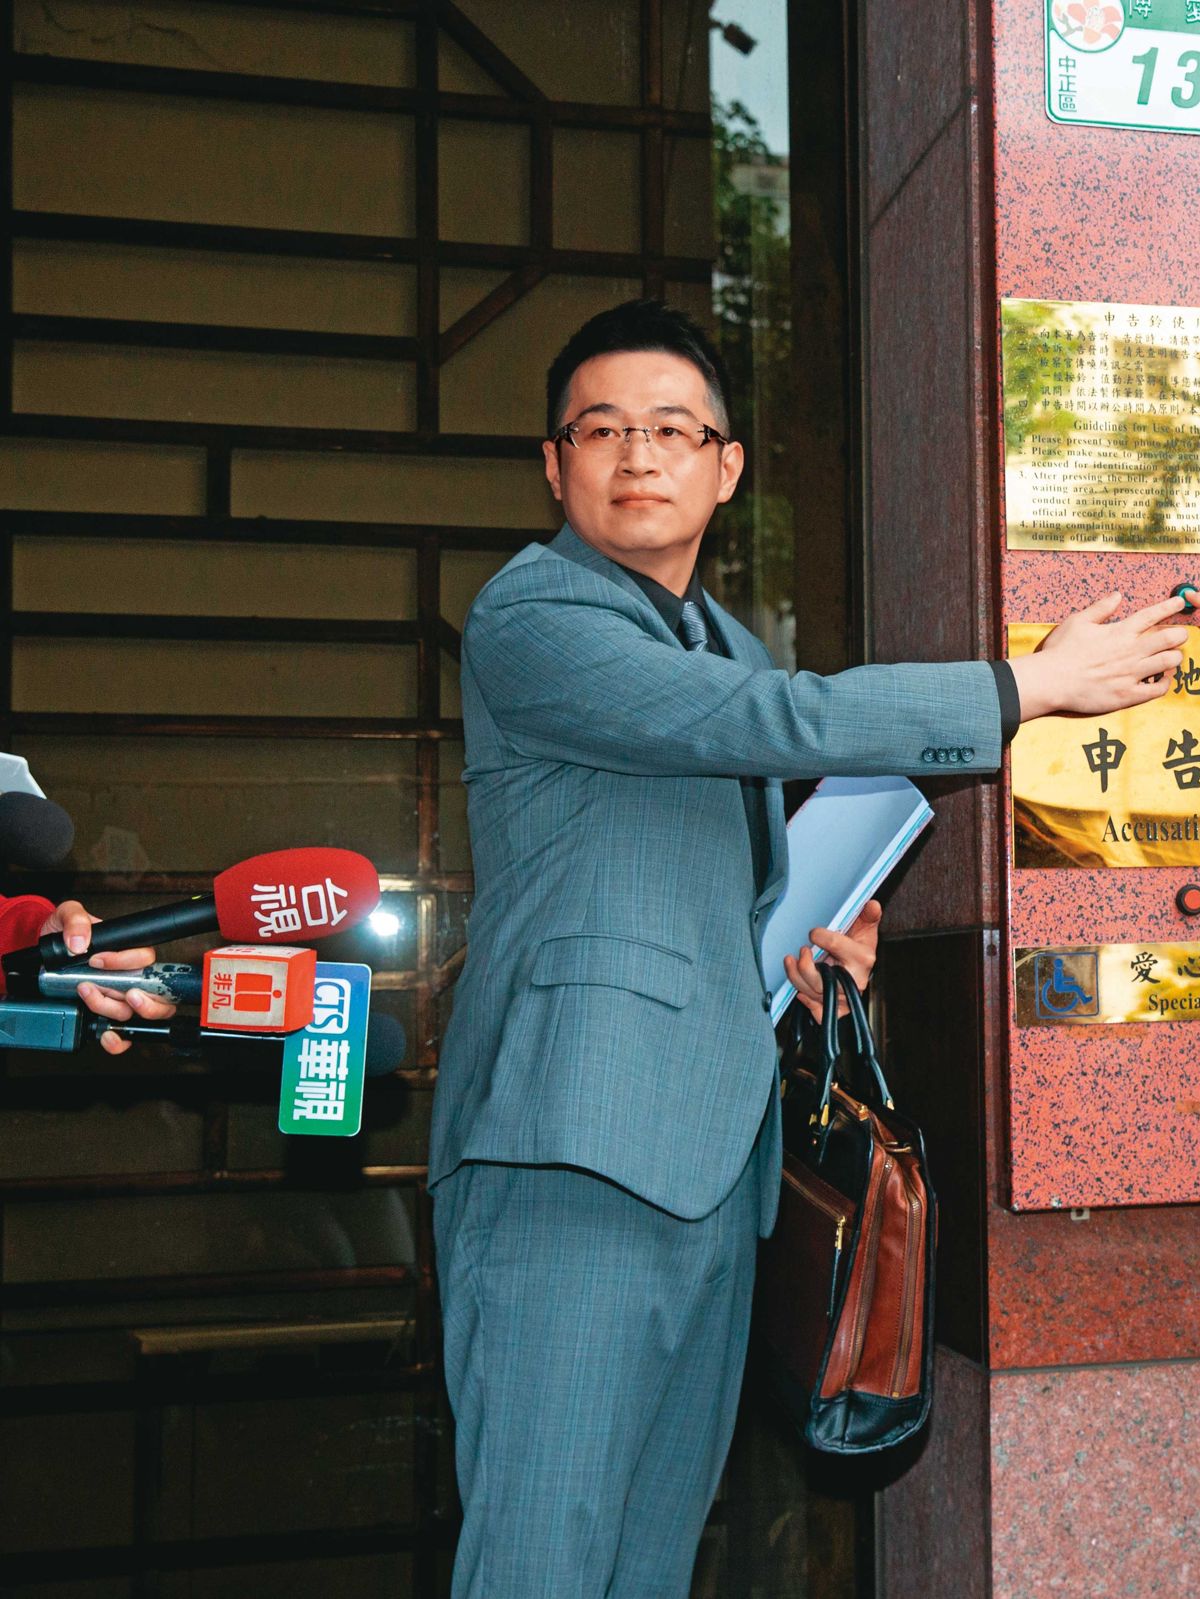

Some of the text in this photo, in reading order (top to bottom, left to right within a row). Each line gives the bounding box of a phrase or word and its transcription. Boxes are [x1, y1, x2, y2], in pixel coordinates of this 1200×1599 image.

[1058, 55, 1077, 112] 中正區
[1073, 420, 1128, 432] Guidelines
[1133, 421, 1147, 433] for
[1152, 422, 1172, 434] Use
[1175, 423, 1185, 434] of
[1032, 434, 1062, 445] Please
[1066, 436, 1102, 448] present
[1107, 438, 1129, 449] your
[1134, 439, 1160, 450] photo
[1032, 447, 1062, 457] Please
[1067, 448, 1093, 458] make
[1123, 450, 1132, 459] to
[1138, 450, 1174, 461] provide
[1031, 460, 1069, 468] accused
[1074, 460, 1088, 469] for
[1093, 461, 1158, 471] identification
[1032, 471, 1056, 480] After
[1062, 472, 1102, 483] pressing
[1107, 474, 1122, 482] the
[1032, 484, 1068, 494] waiting
[1073, 487, 1097, 495] area.
[1113, 486, 1164, 497] prosecutor
[1169, 489, 1180, 497] or
[1032, 497, 1070, 505] conduct
[1075, 498, 1087, 506] an
[1092, 498, 1127, 509] inquiry
[1133, 498, 1150, 507] and
[1032, 509, 1067, 518] official
[1072, 510, 1104, 519] record
[1108, 510, 1116, 519] is
[1032, 520, 1061, 531] Filing
[1129, 522, 1140, 531] in
[1031, 533, 1065, 543] during
[1070, 533, 1097, 542] office
[251, 877, 349, 938] 台視
[212, 972, 233, 1010] 非凡
[292, 1037, 351, 1121] 華視
